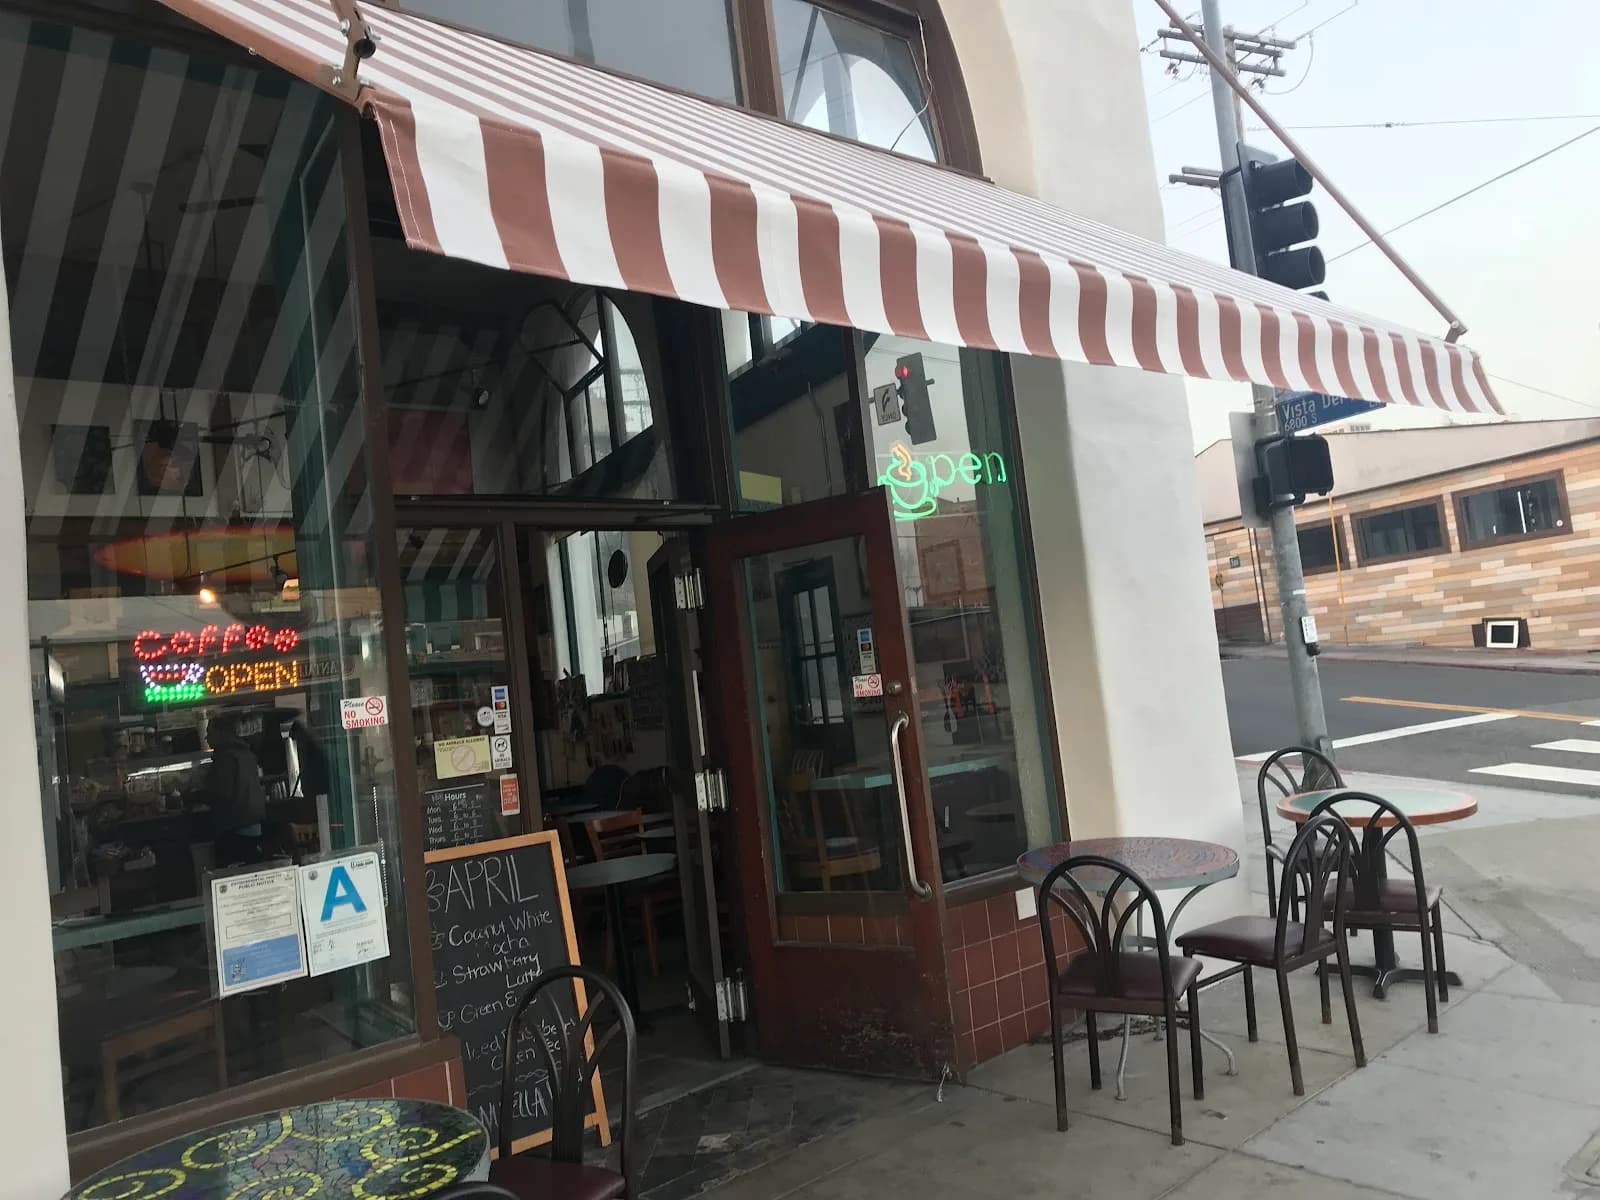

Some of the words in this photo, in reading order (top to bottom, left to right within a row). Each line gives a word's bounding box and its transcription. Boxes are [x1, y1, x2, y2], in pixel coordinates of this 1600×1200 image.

[1282, 399, 1316, 420] Vista
[1284, 417, 1308, 432] 6800
[1311, 412, 1318, 424] S
[205, 660, 298, 694] OPEN
[343, 700, 365, 710] Please
[344, 710, 357, 720] NO
[345, 716, 386, 729] SMOKING
[444, 792, 467, 801] Hours
[320, 865, 368, 923] A
[445, 855, 539, 913] APRIL
[509, 909, 553, 931] White
